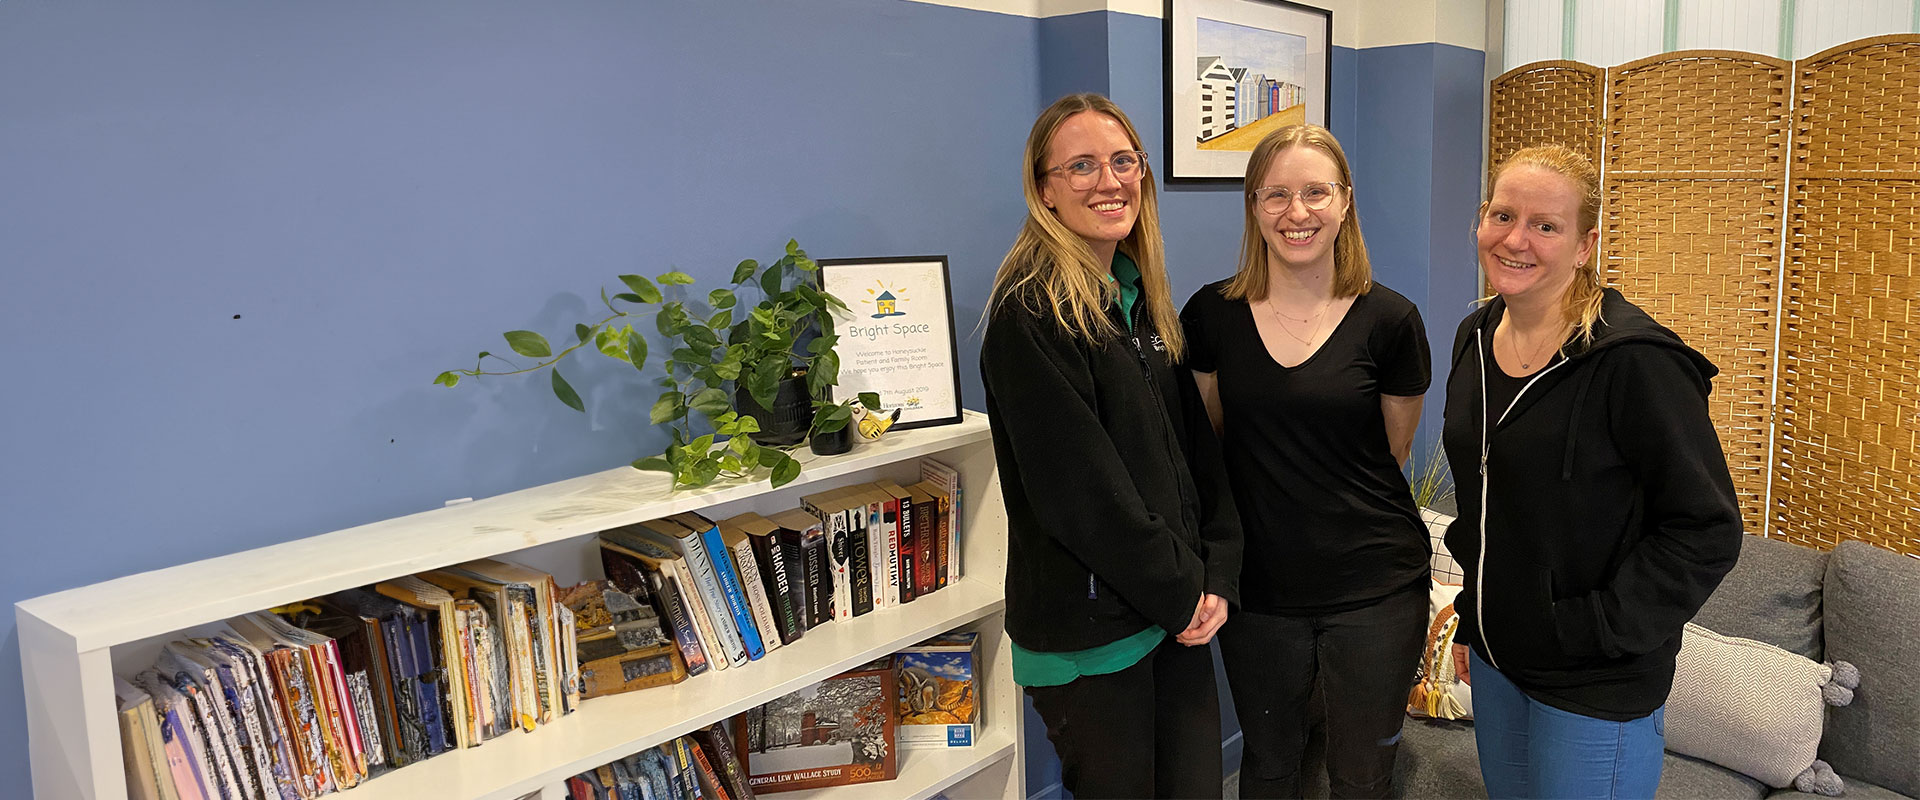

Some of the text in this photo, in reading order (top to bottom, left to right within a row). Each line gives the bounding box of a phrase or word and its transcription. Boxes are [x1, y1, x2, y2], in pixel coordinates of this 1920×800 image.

[849, 323, 930, 341] Bright Space
[891, 356, 910, 364] Family
[892, 347, 926, 356] Honeysuckle
[853, 367, 868, 375] hope
[868, 366, 879, 375] you
[880, 364, 896, 373] enjoy
[909, 362, 926, 371] Bright
[894, 388, 915, 397] August
[901, 500, 911, 538] 13 BULLETS
[688, 537, 710, 577] DIANA
[854, 542, 868, 587] TOWER
[771, 545, 789, 596] MO HAYDER
[808, 548, 819, 587] CUSSLER
[751, 584, 760, 603] ROSS
[749, 768, 842, 786] GENERAL LEW WALLACE STUDY
[849, 767, 871, 778] 500
